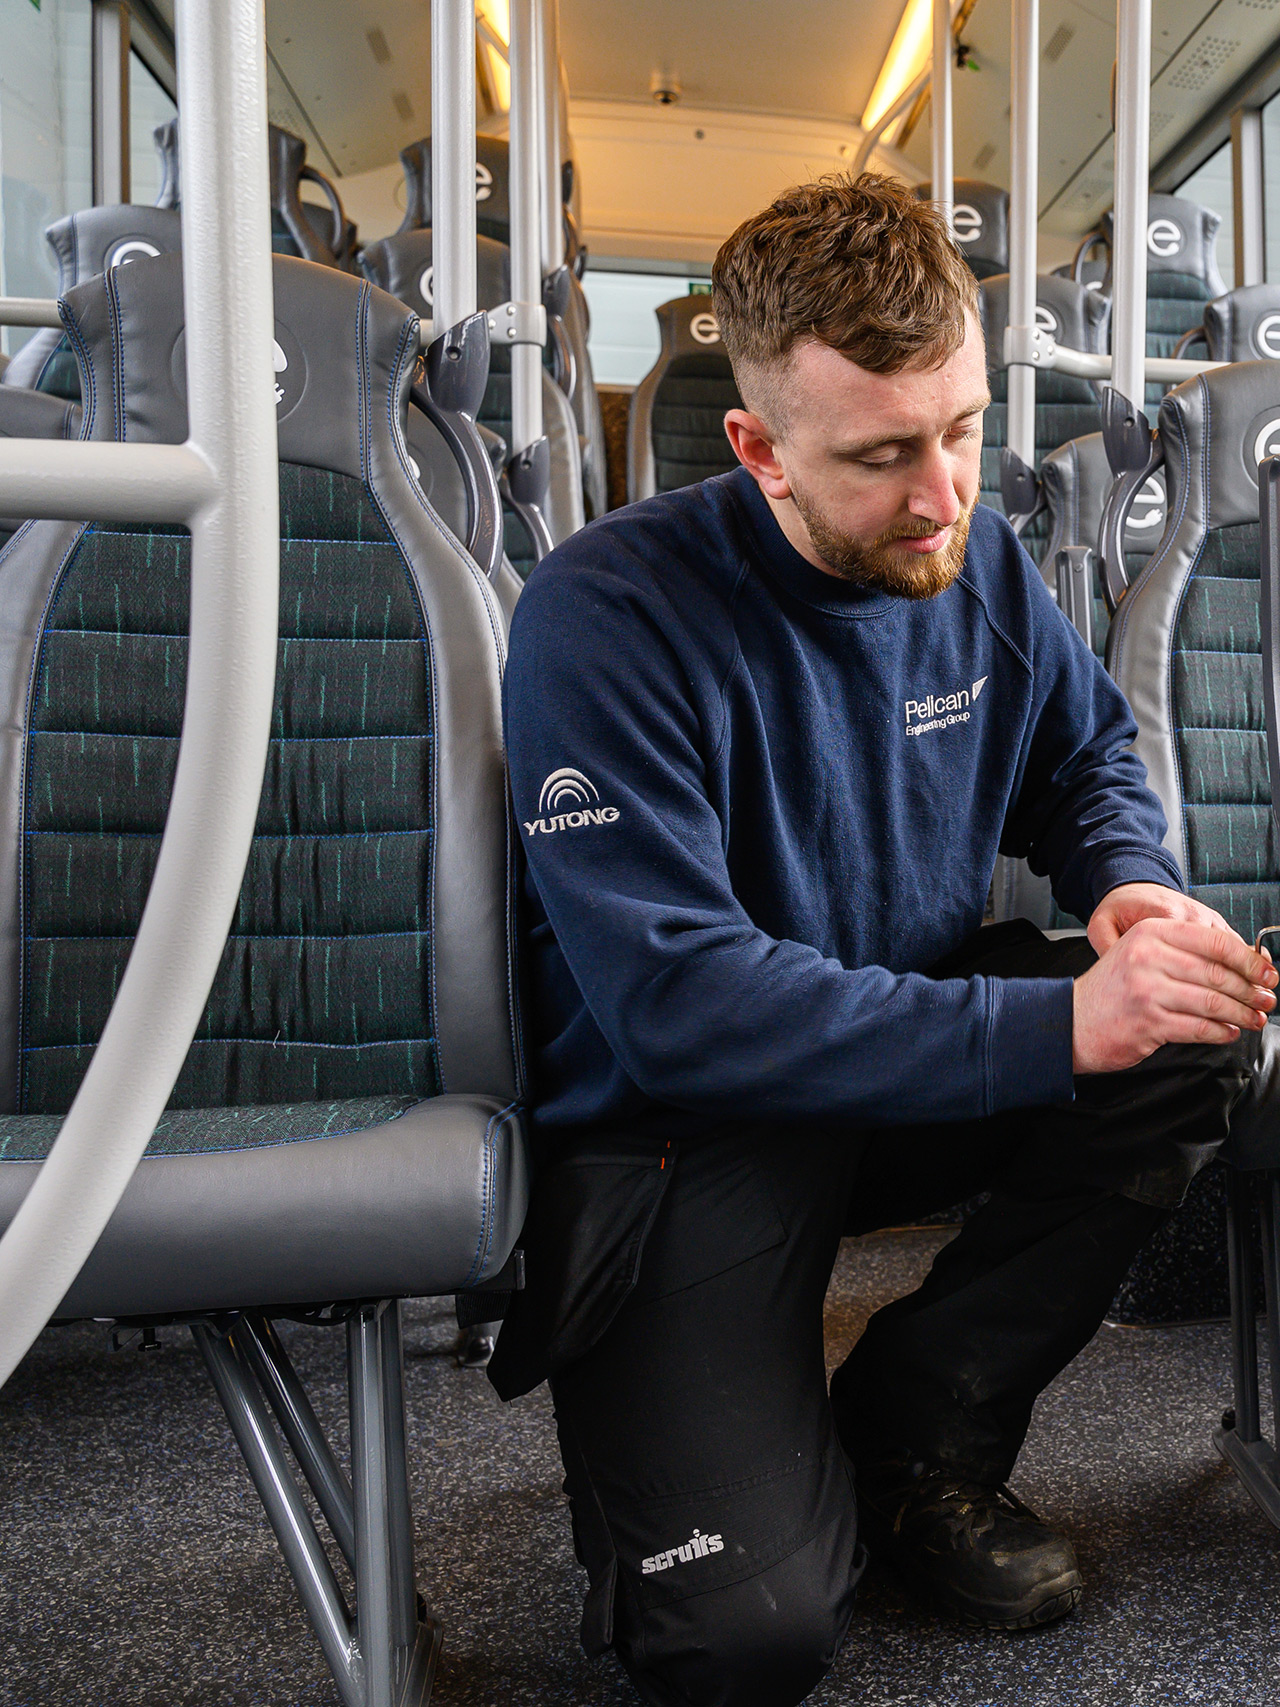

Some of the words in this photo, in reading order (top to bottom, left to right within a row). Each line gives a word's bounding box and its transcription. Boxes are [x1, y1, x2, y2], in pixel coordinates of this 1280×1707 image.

[905, 690, 969, 723] Pelican
[906, 718, 946, 736] Engineering
[946, 711, 970, 724] Group
[523, 806, 620, 836] YUTONG
